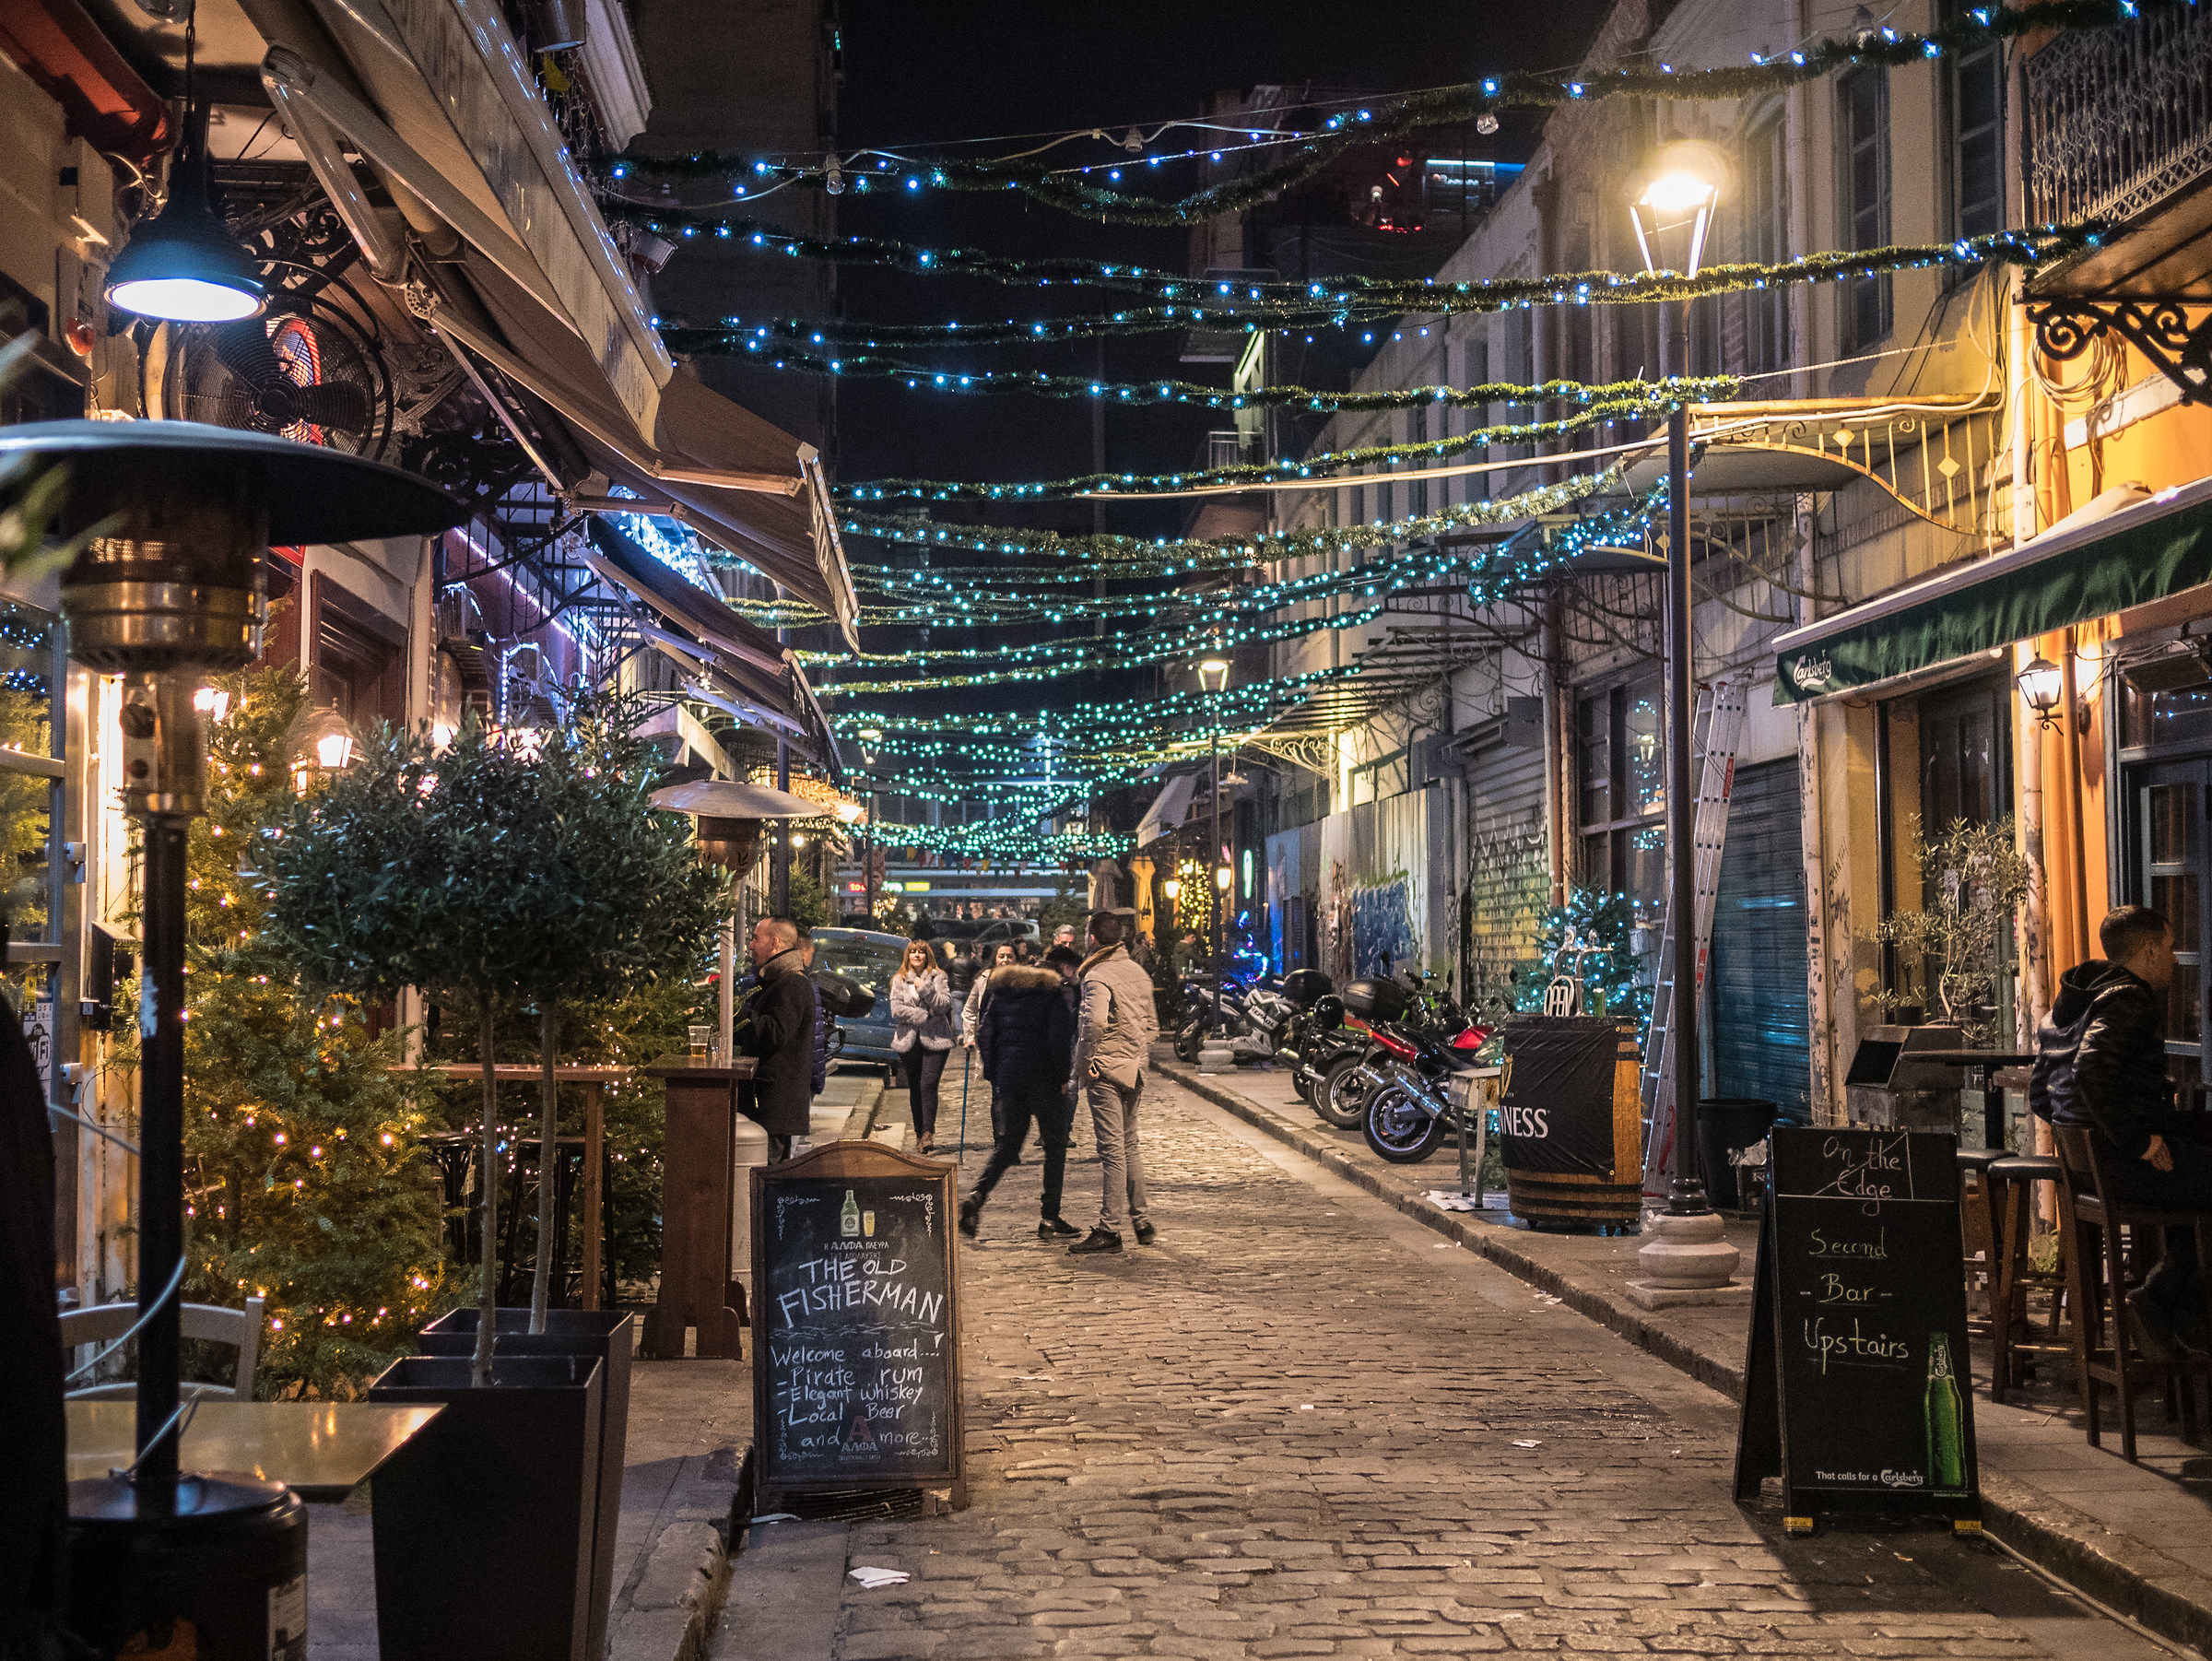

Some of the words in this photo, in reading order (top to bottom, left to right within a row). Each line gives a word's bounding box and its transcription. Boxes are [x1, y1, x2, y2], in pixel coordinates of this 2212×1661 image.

[1794, 650, 1831, 689] Carlsberg
[1823, 1137, 1854, 1167] On
[1865, 1137, 1902, 1171] the
[1837, 1168, 1892, 1216] Edge
[831, 1241, 864, 1250] ΑΛΦΑ
[1808, 1226, 1888, 1258] Second
[799, 1258, 857, 1284] THE
[863, 1258, 907, 1276] OLD
[1818, 1273, 1874, 1303] Bar
[776, 1279, 944, 1329] FISHERMAN
[771, 1345, 845, 1367] Welcome
[1805, 1317, 1909, 1374] Upstairs
[880, 1367, 923, 1385] rum
[860, 1384, 923, 1405] whiskey
[865, 1402, 905, 1421] Beer
[801, 1426, 841, 1447] and
[1815, 1470, 1836, 1480] That
[1837, 1471, 1856, 1480] calls
[1858, 1472, 1870, 1481] for
[1880, 1469, 1924, 1487] Carlsberg
